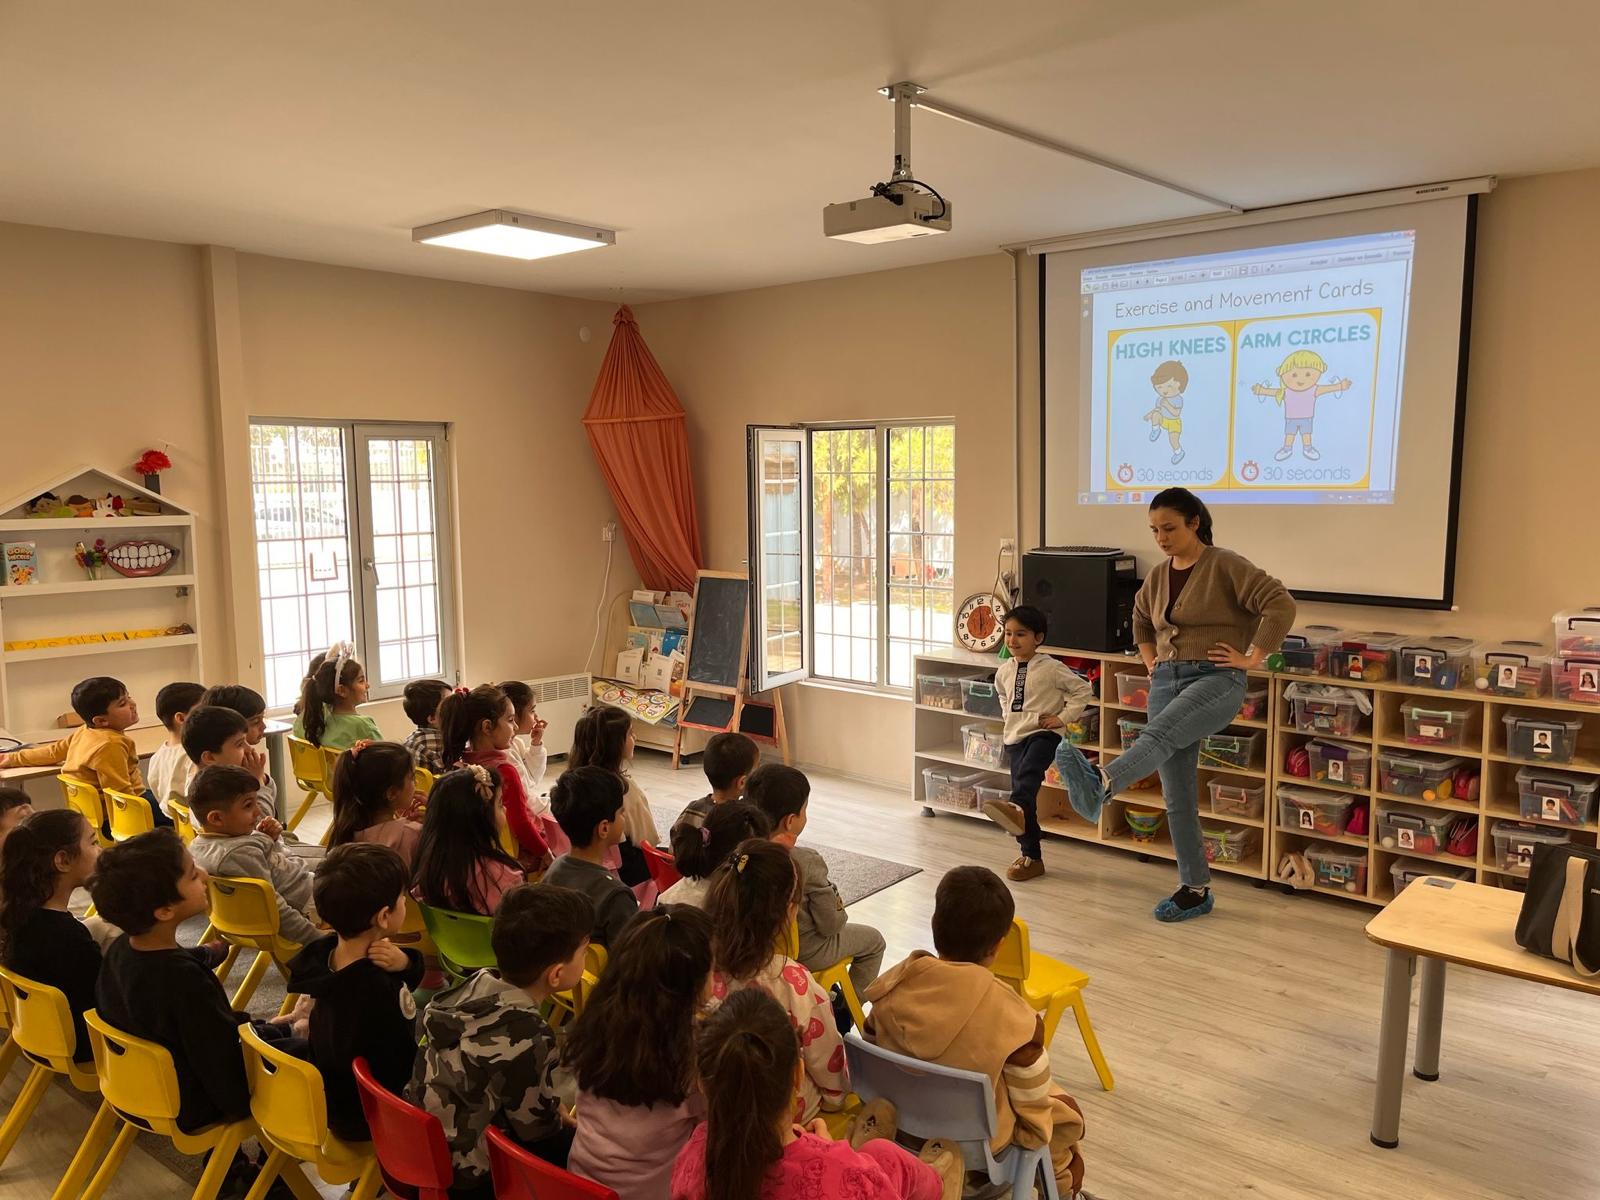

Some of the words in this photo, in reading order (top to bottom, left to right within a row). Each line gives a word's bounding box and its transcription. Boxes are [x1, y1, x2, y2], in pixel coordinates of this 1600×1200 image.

[1115, 299, 1178, 318] Exercise
[1184, 294, 1213, 312] and
[1219, 285, 1312, 309] Movement
[1319, 279, 1374, 299] Cards
[1115, 341, 1163, 359] HIGH
[1169, 336, 1227, 356] KNEES
[1240, 331, 1282, 349] ARM
[1288, 325, 1371, 346] CIRCLES
[1137, 468, 1154, 481] 30
[1157, 464, 1213, 481] seconds
[1263, 466, 1283, 481] 30
[1287, 465, 1351, 481] seconds
